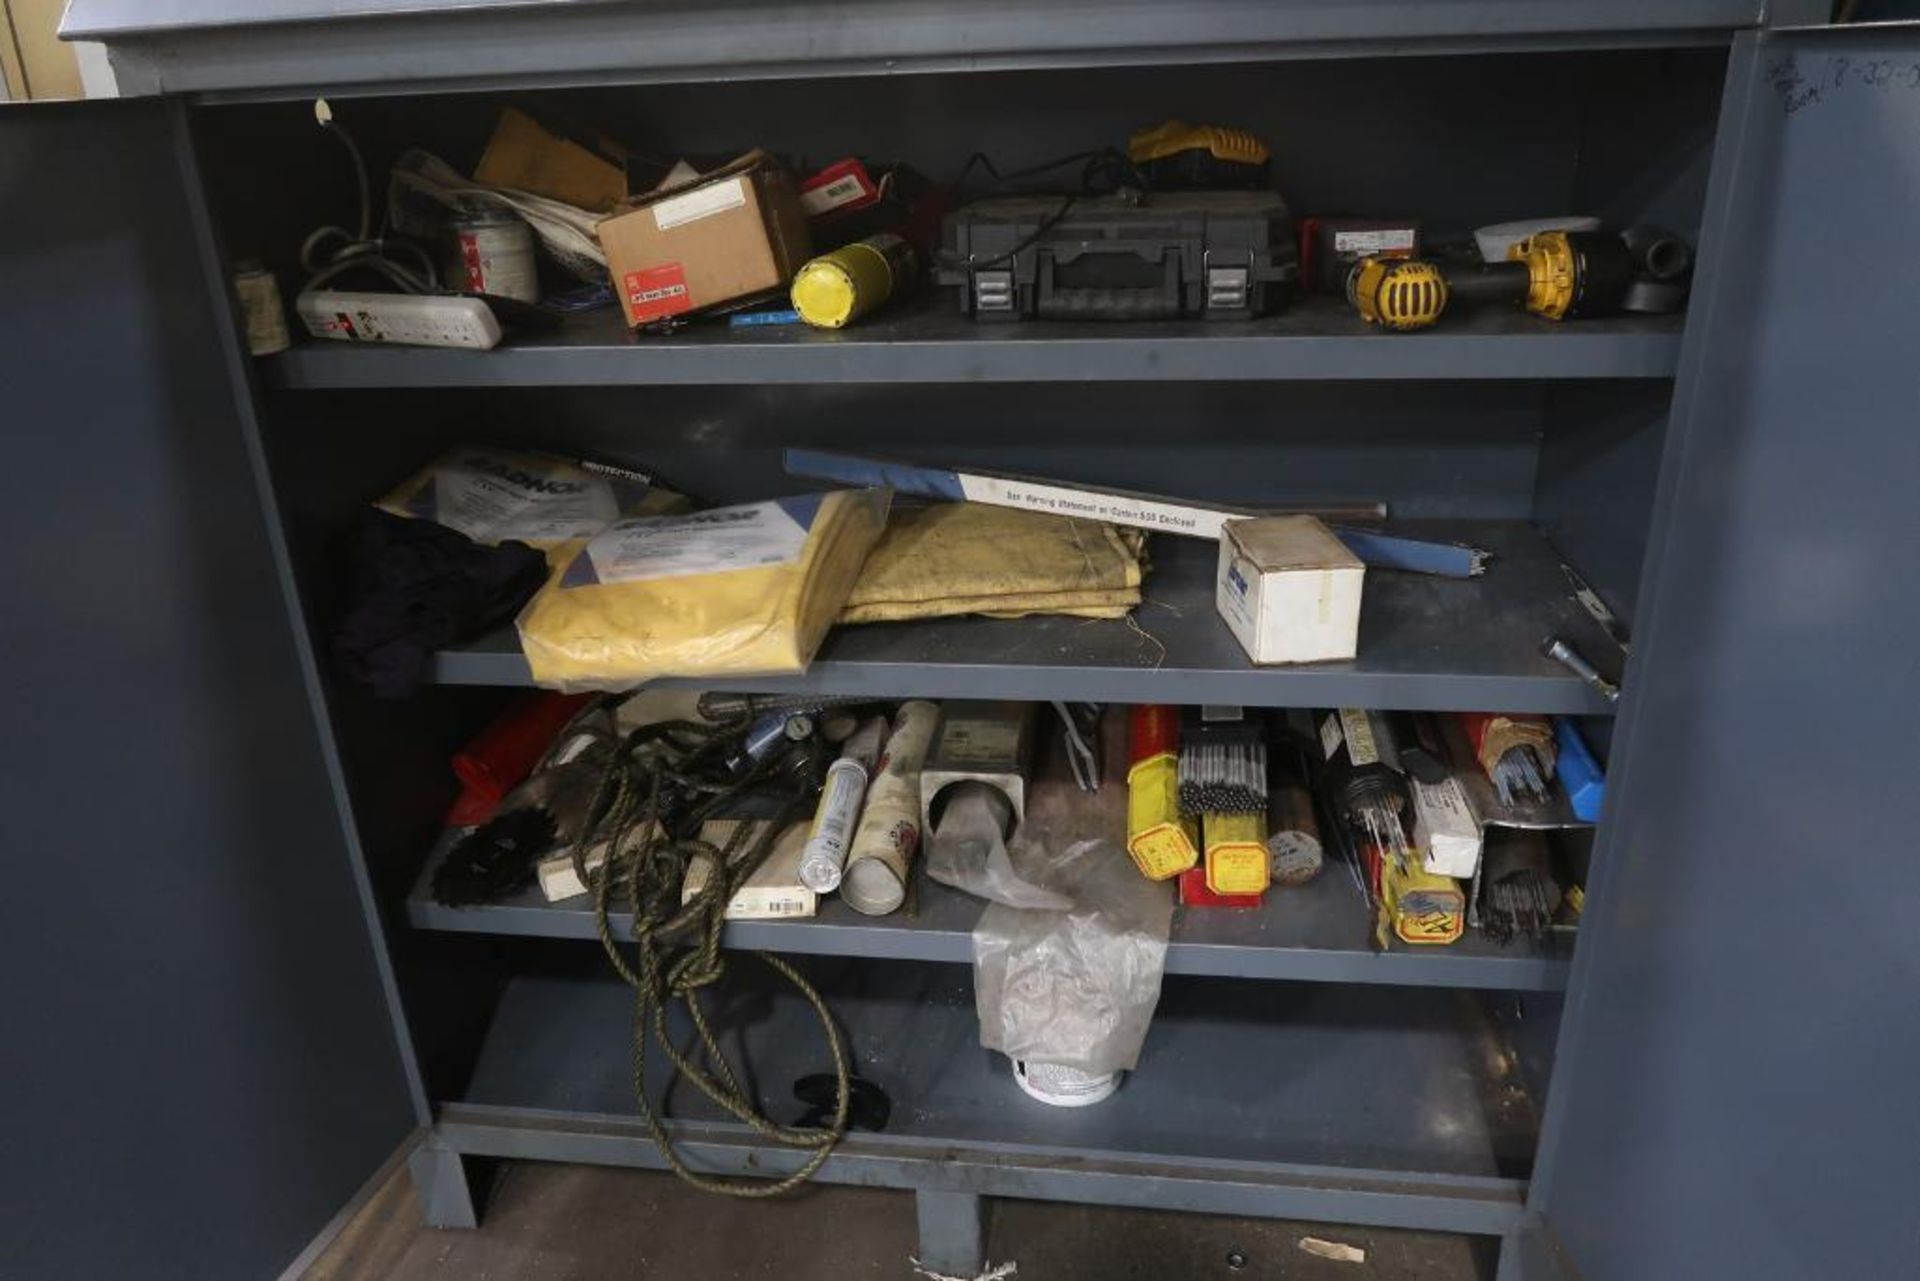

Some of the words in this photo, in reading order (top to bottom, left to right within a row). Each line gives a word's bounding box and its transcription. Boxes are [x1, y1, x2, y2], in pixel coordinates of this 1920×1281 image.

[1026, 494, 1056, 508] Warning
[1058, 499, 1097, 512] Statement
[1159, 514, 1196, 528] Enclosed
